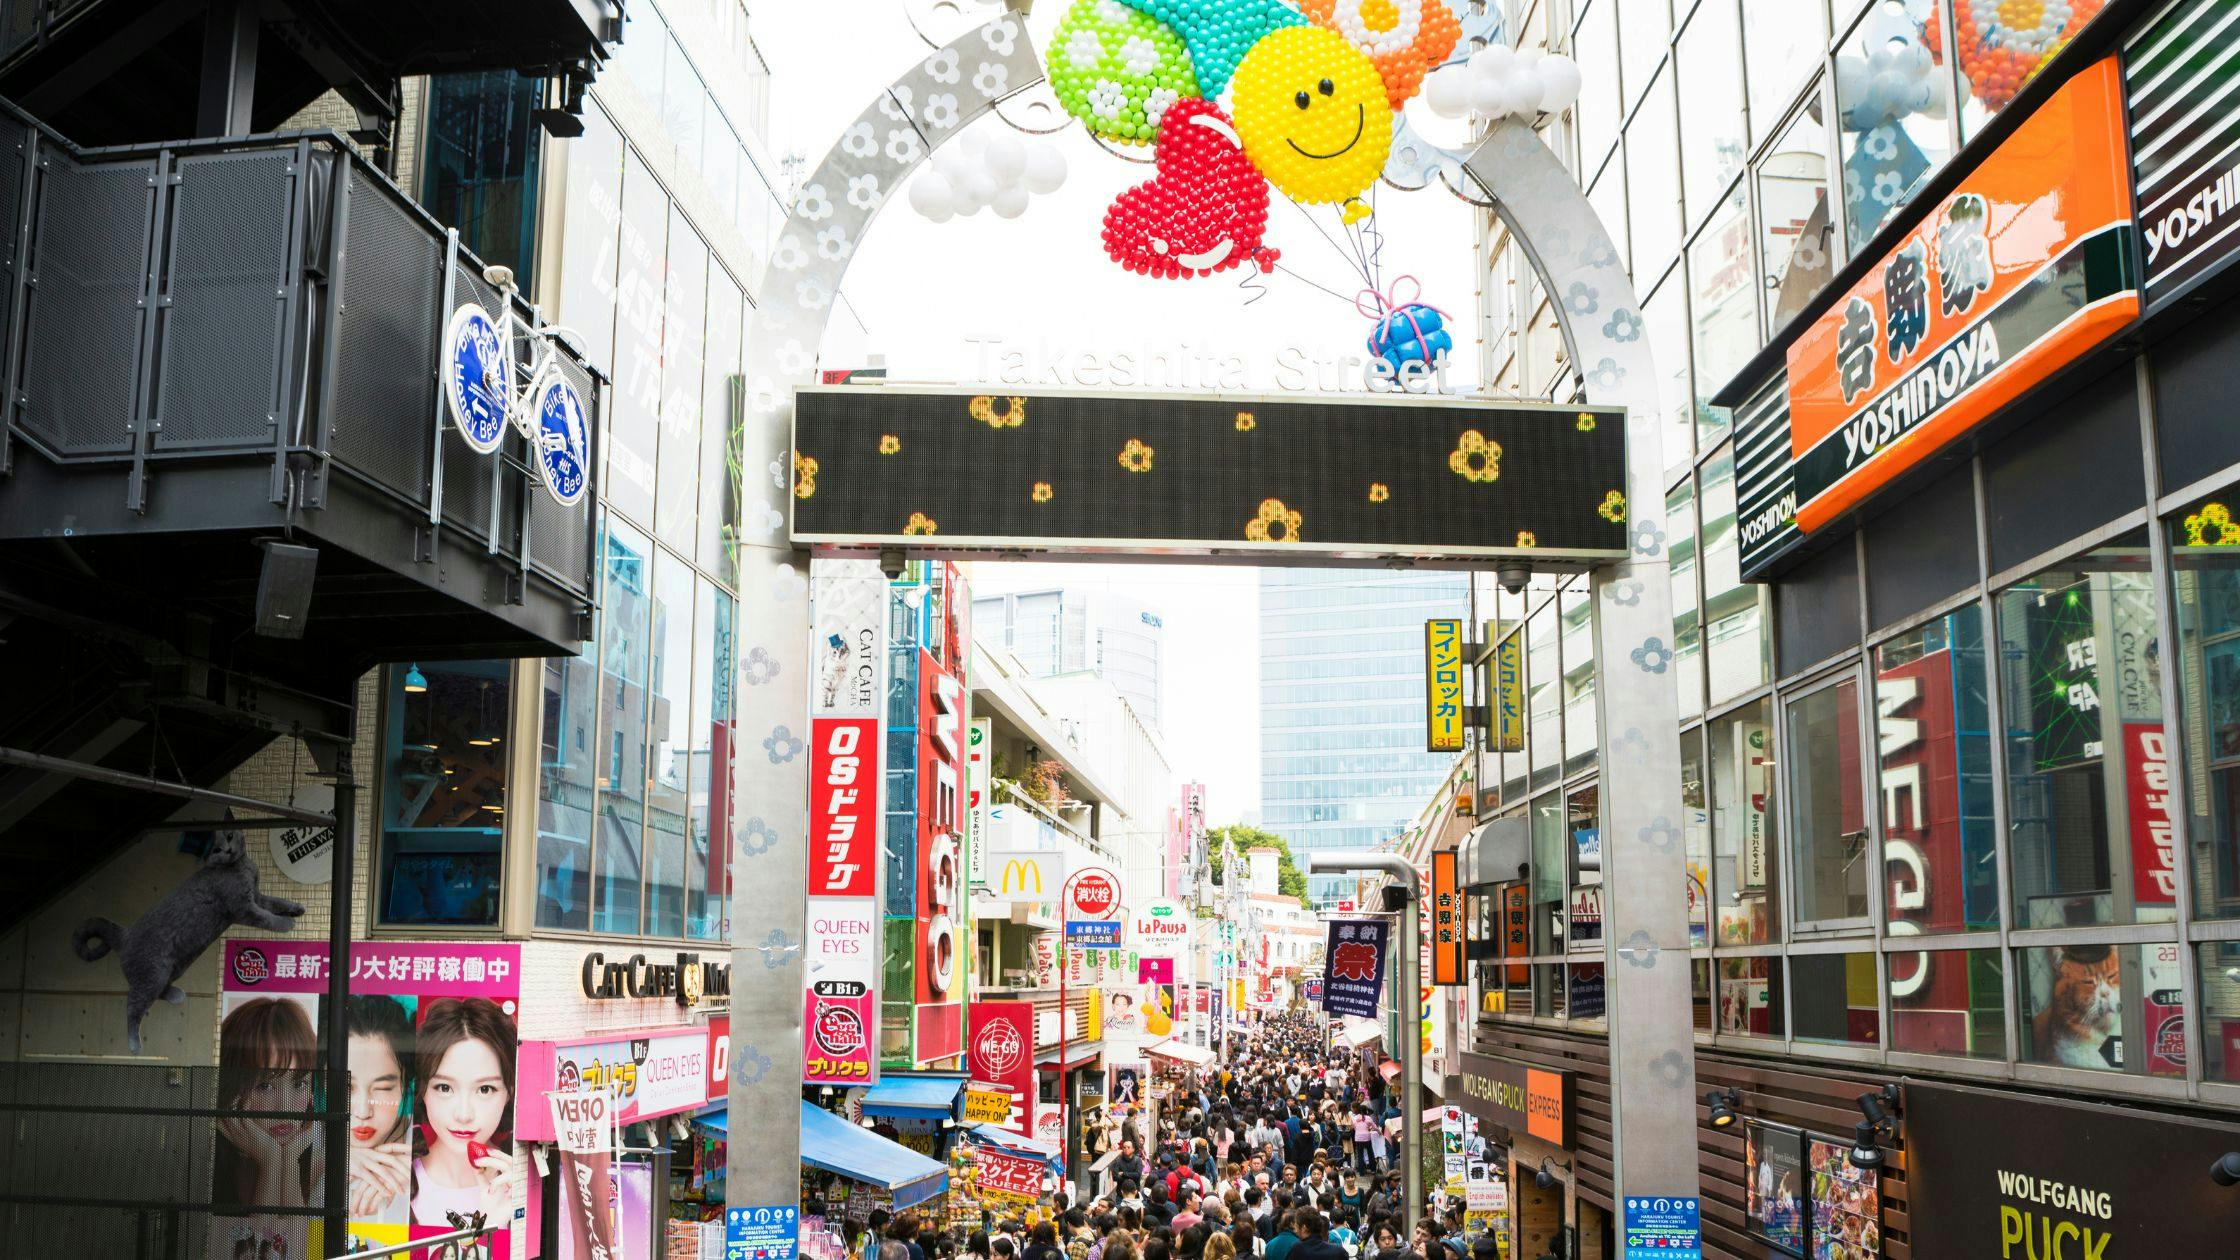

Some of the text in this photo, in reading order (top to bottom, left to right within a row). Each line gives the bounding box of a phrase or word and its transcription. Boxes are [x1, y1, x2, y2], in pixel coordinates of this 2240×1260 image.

[1837, 193, 1994, 406] 吉野家
[965, 334, 1457, 395] Takeshita Street
[1844, 321, 2000, 469] YOSHINOYA
[858, 629, 873, 706] CAT CAFE
[1434, 622, 1459, 734] コインロッカー
[1434, 737, 1460, 747] 3F
[826, 726, 860, 889] OSドラッグ
[292, 841, 317, 860] THIS
[1077, 887, 1110, 903] 消火栓
[814, 919, 869, 935] QUEEN
[1438, 893, 1451, 943] 吉野家
[822, 940, 859, 953] EYES
[1332, 942, 1378, 981] 祭
[275, 954, 509, 982] 最新リ大好評稼働中
[646, 1053, 701, 1084] QUEEN EYES
[967, 1094, 1011, 1107] ハッピーワン
[1462, 1072, 1525, 1113] WOLFGANG PUCK
[1529, 1093, 1560, 1121] EXPRESS
[965, 1108, 991, 1119] HAPPY
[974, 1177, 1040, 1194] SQUEEZE
[976, 1162, 1042, 1187] スクイーズ
[1998, 1169, 2112, 1220] WOLFGANG
[2001, 1205, 2112, 1260] PUCK
